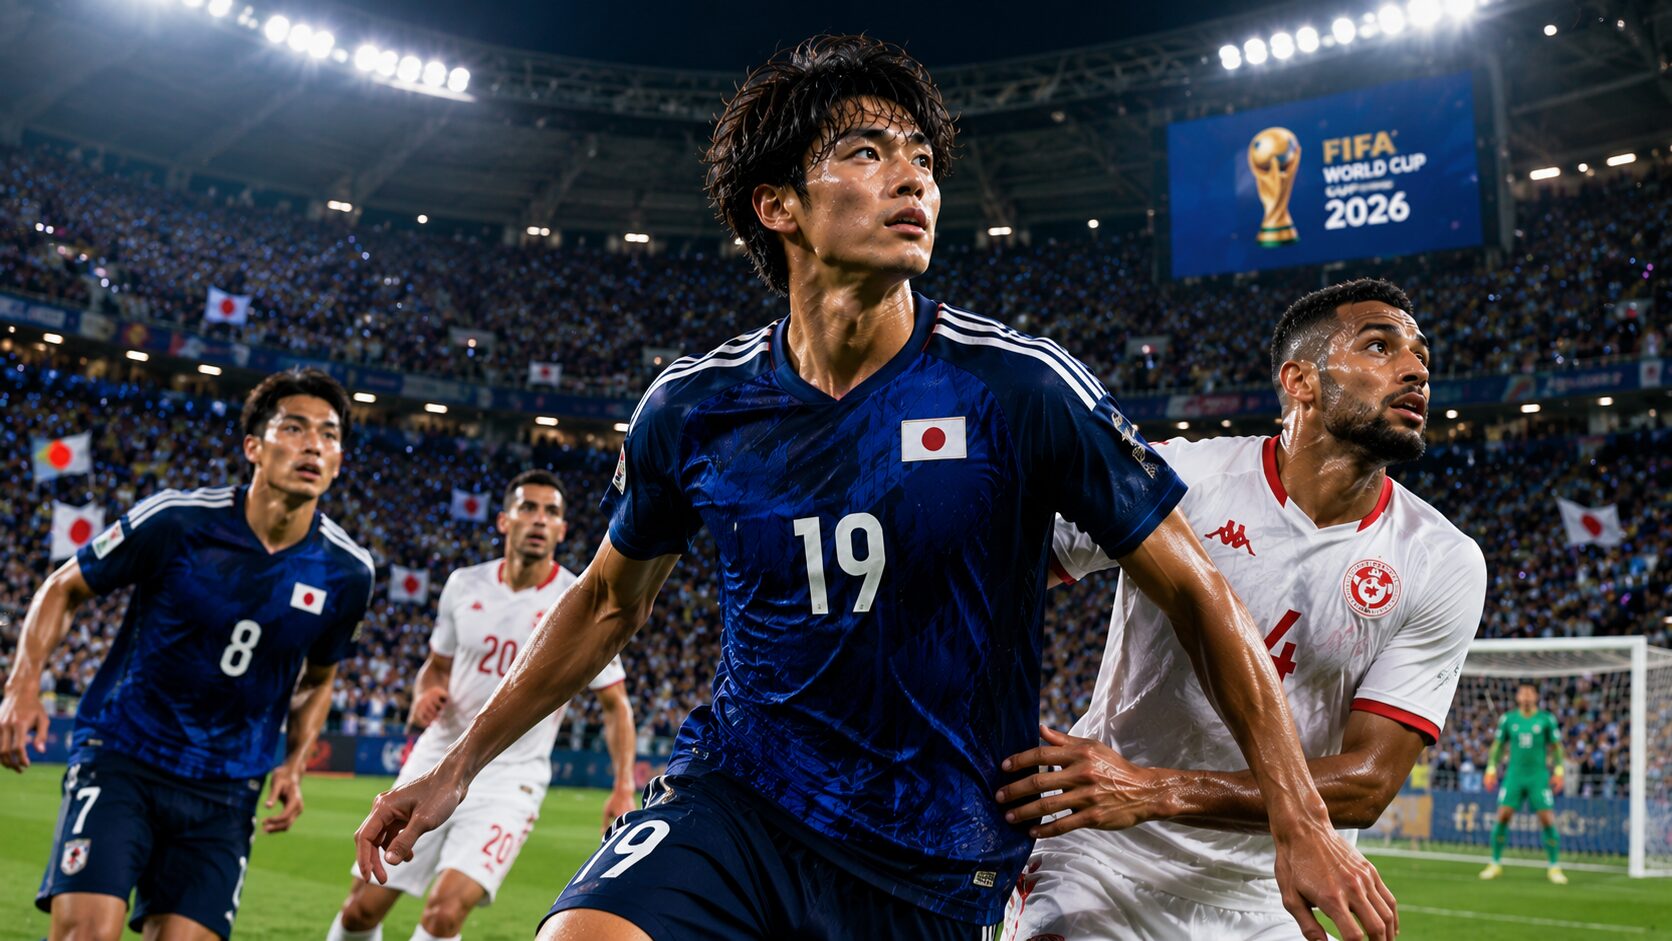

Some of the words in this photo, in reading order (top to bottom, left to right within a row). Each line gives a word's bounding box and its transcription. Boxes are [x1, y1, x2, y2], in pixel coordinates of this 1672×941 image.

[1323, 130, 1397, 164] FIFA
[1323, 159, 1387, 183] WORLD
[1389, 153, 1427, 175] CUP
[1325, 191, 1411, 230] 2026
[793, 512, 886, 615] 19
[220, 619, 261, 677] 8
[478, 635, 517, 678] 20
[1264, 609, 1301, 682] 4
[72, 786, 101, 834] 7
[482, 824, 513, 864] 20
[572, 820, 671, 885] 19
